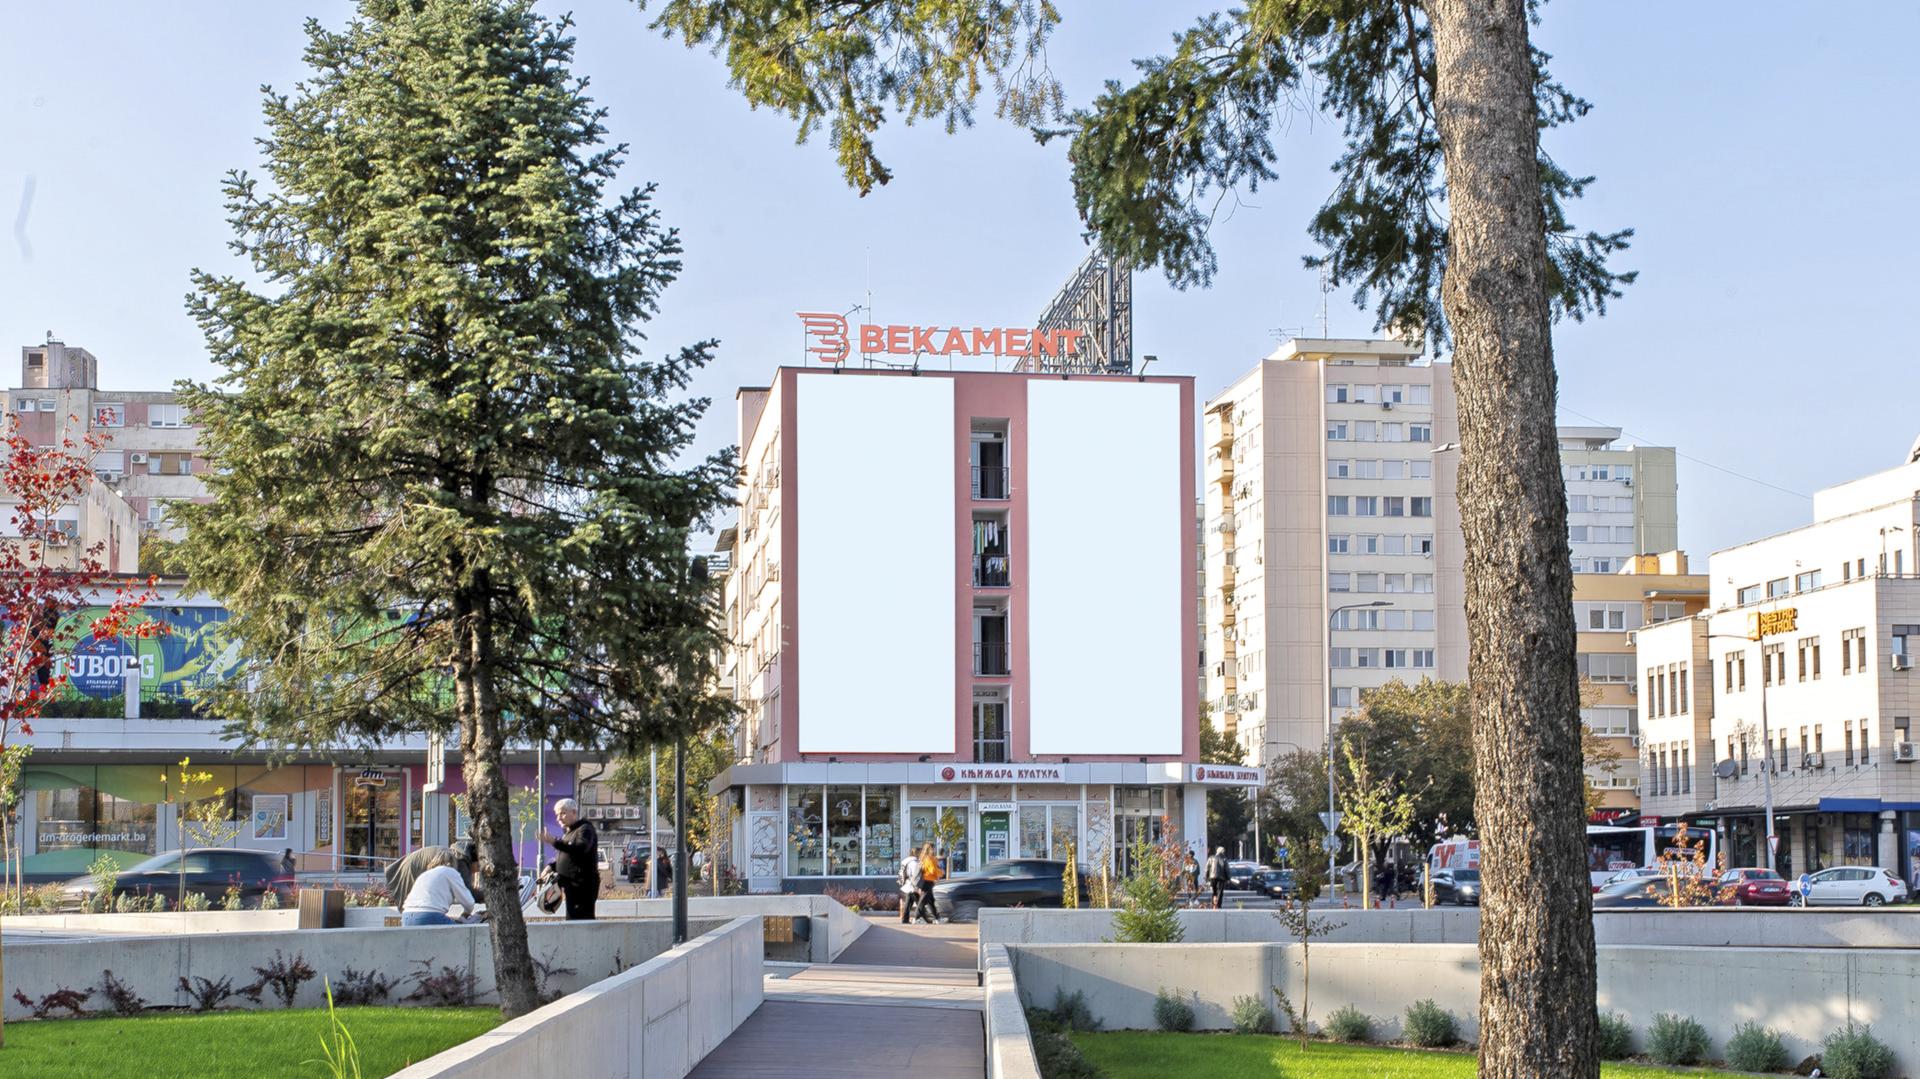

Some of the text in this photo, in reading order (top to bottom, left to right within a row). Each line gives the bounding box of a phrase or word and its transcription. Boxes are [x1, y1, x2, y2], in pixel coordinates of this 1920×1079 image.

[860, 324, 1083, 358] BEKAMENT
[1760, 608, 1798, 625] NESTRO
[1760, 619, 1798, 636] PETROL
[362, 768, 384, 779] dm
[961, 768, 1013, 779] КЊИЖАРА
[40, 831, 146, 843] dm-drogeriemarkt.ba
